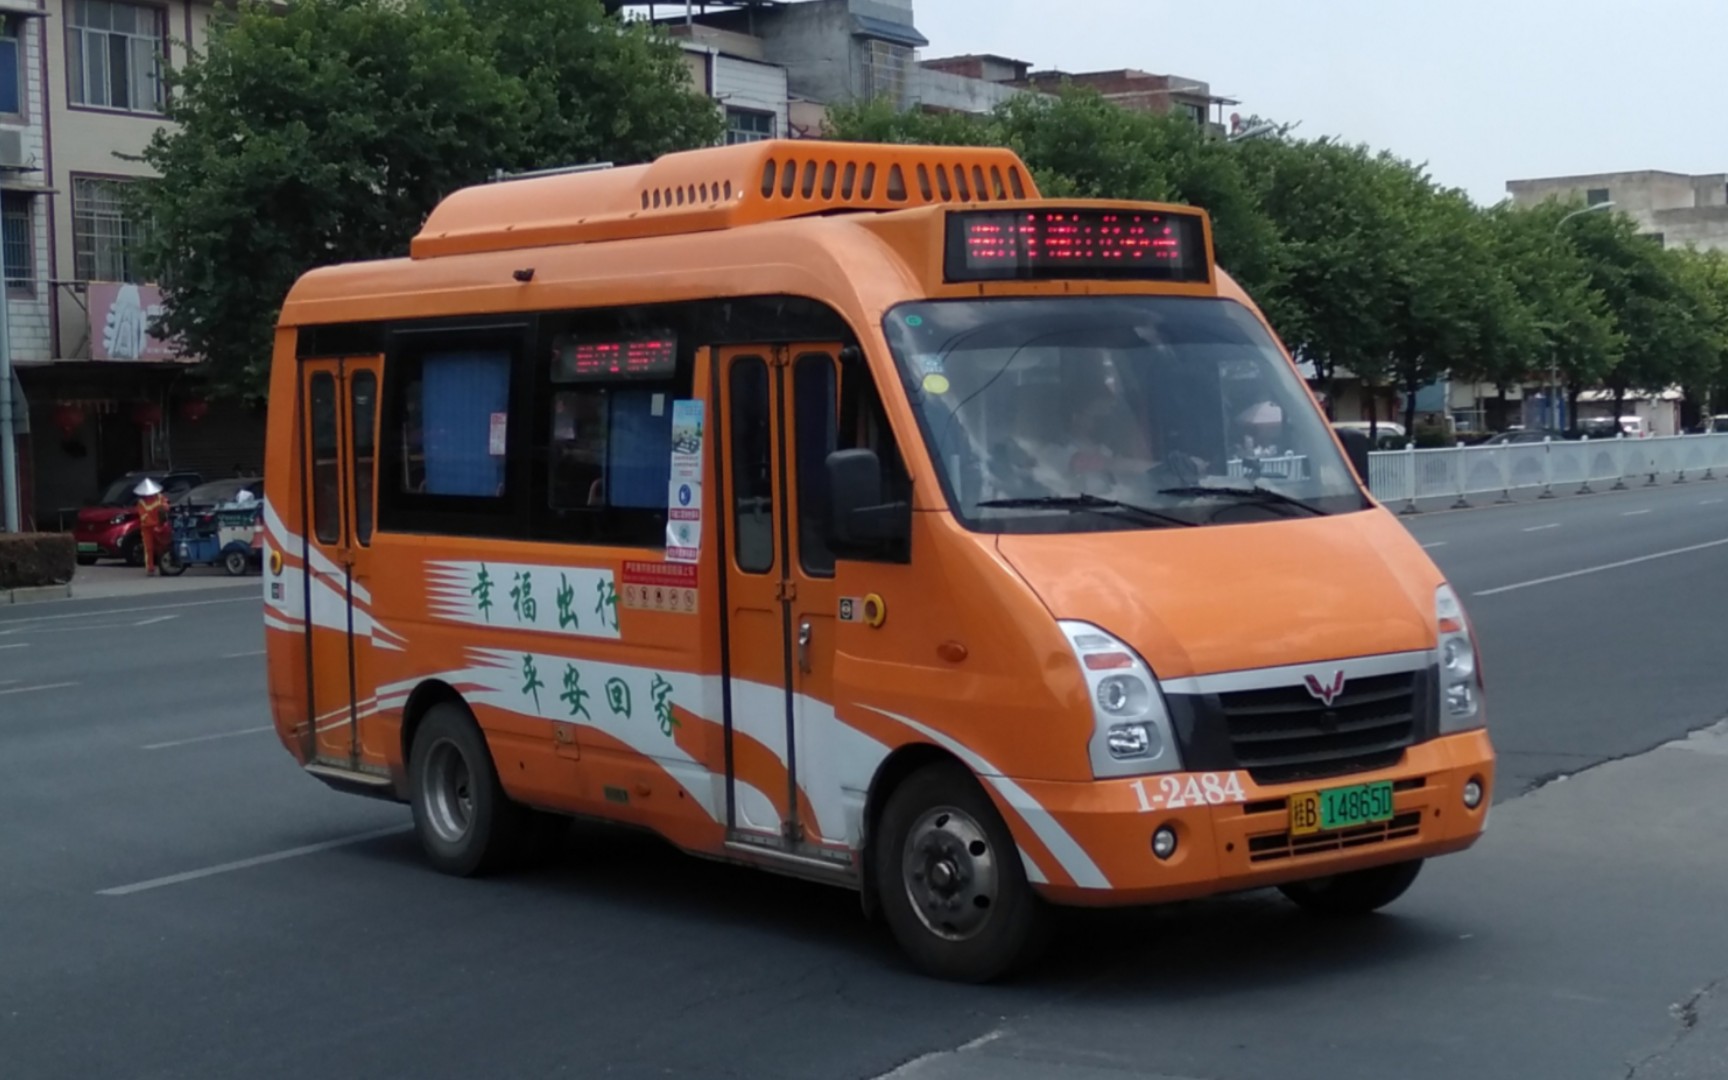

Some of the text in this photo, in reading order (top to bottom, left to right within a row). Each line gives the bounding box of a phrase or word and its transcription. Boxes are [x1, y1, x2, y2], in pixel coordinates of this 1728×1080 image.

[471, 562, 621, 632] 幸福出行
[521, 654, 682, 737] 平安回家
[1130, 771, 1246, 812] 1-2484
